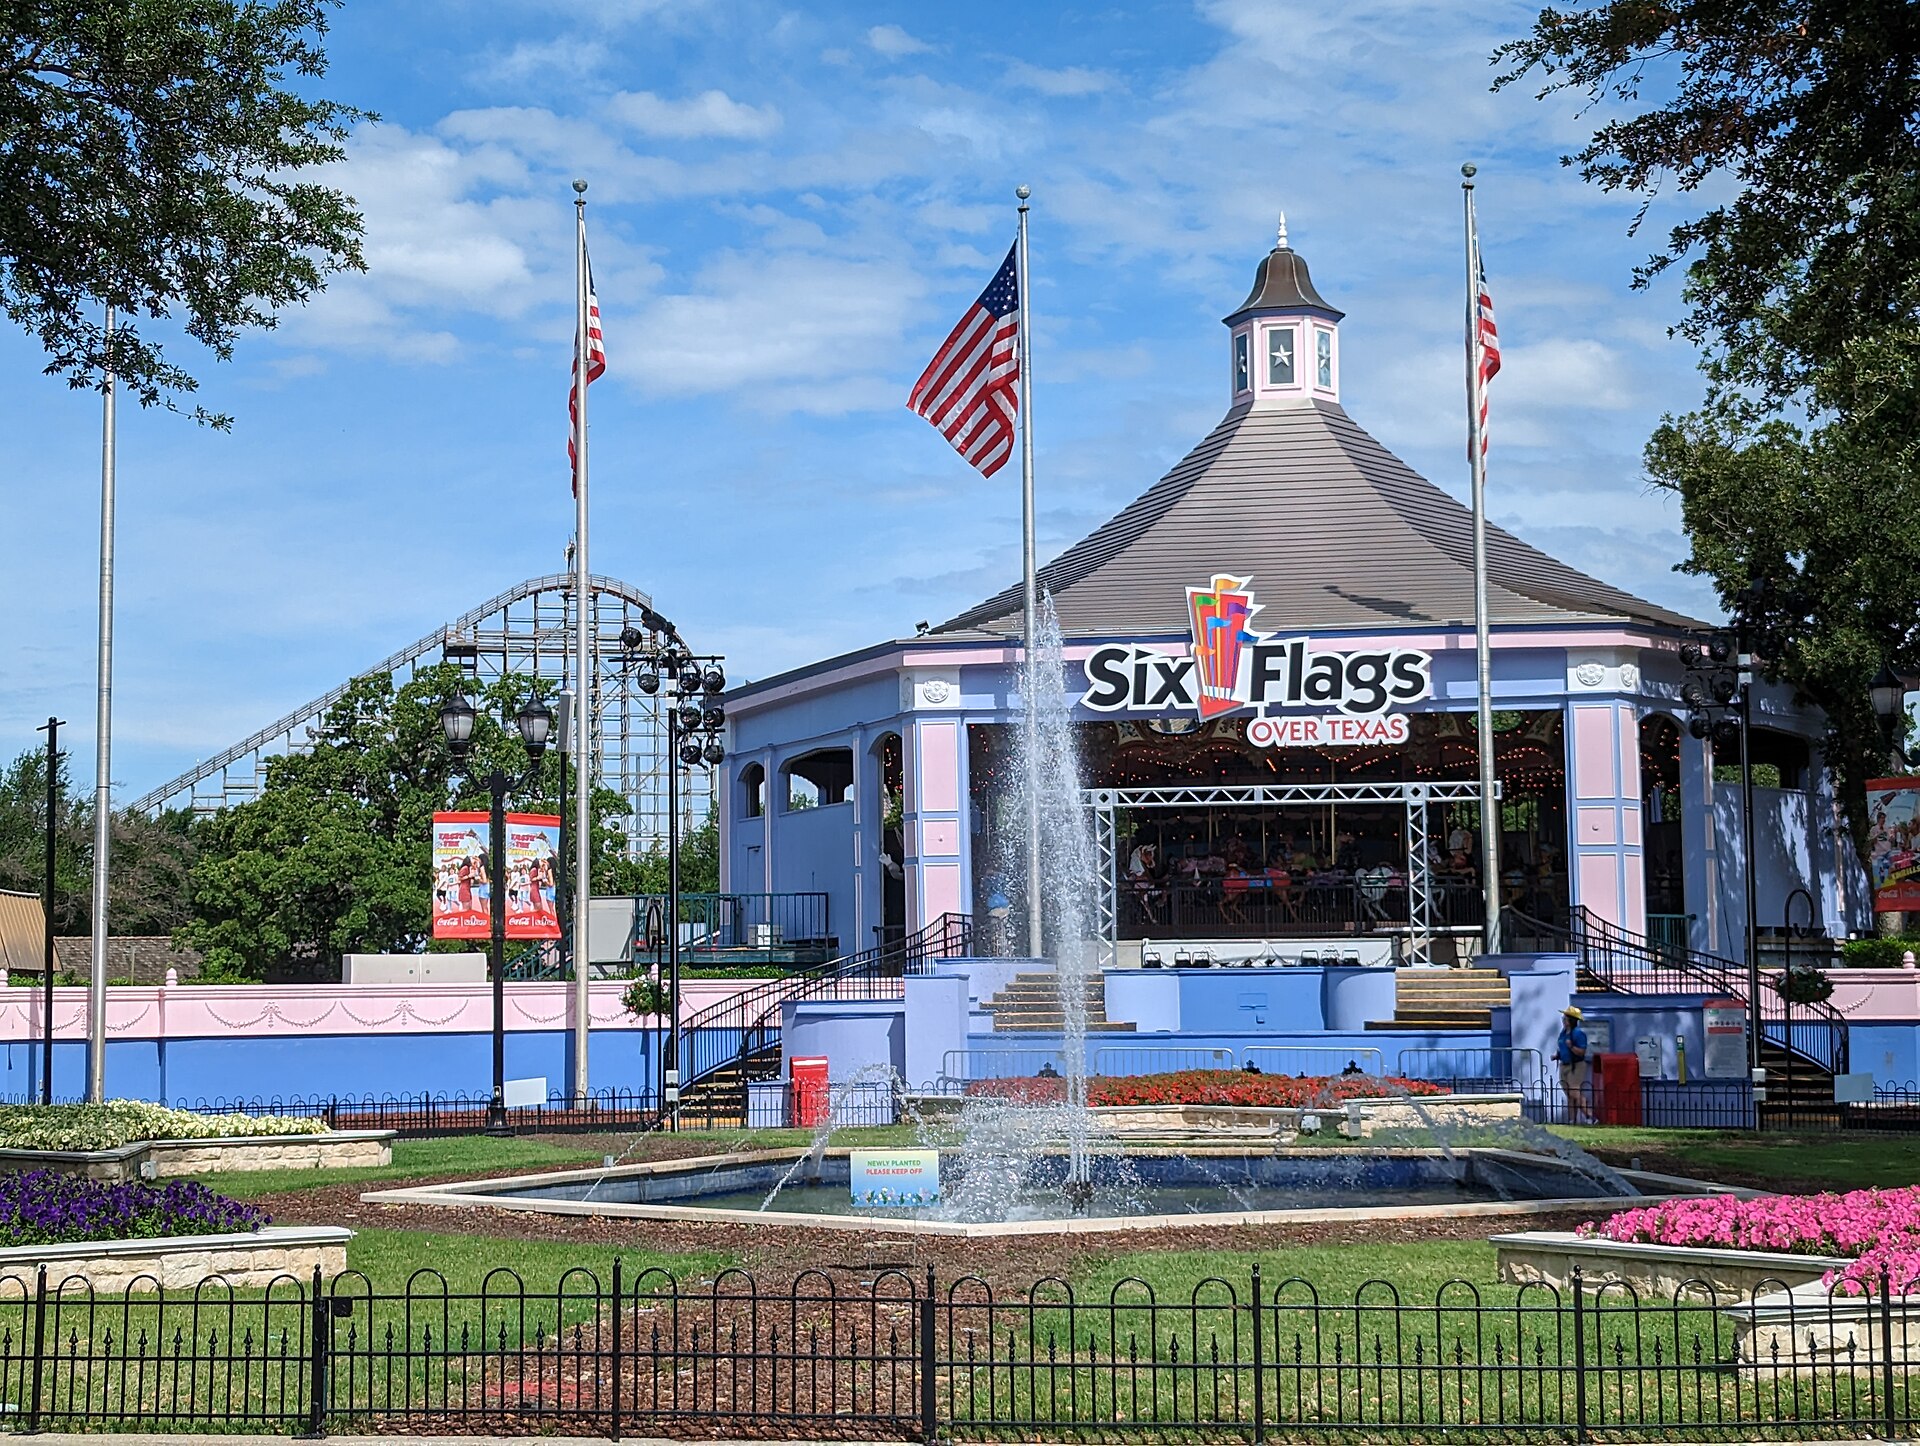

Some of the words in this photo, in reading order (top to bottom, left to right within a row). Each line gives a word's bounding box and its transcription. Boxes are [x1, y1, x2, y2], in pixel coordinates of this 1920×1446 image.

[1087, 647, 1196, 707] Six
[1249, 640, 1426, 713] Flags
[1251, 721, 1318, 742] OVER
[1326, 717, 1405, 741] TEXAS
